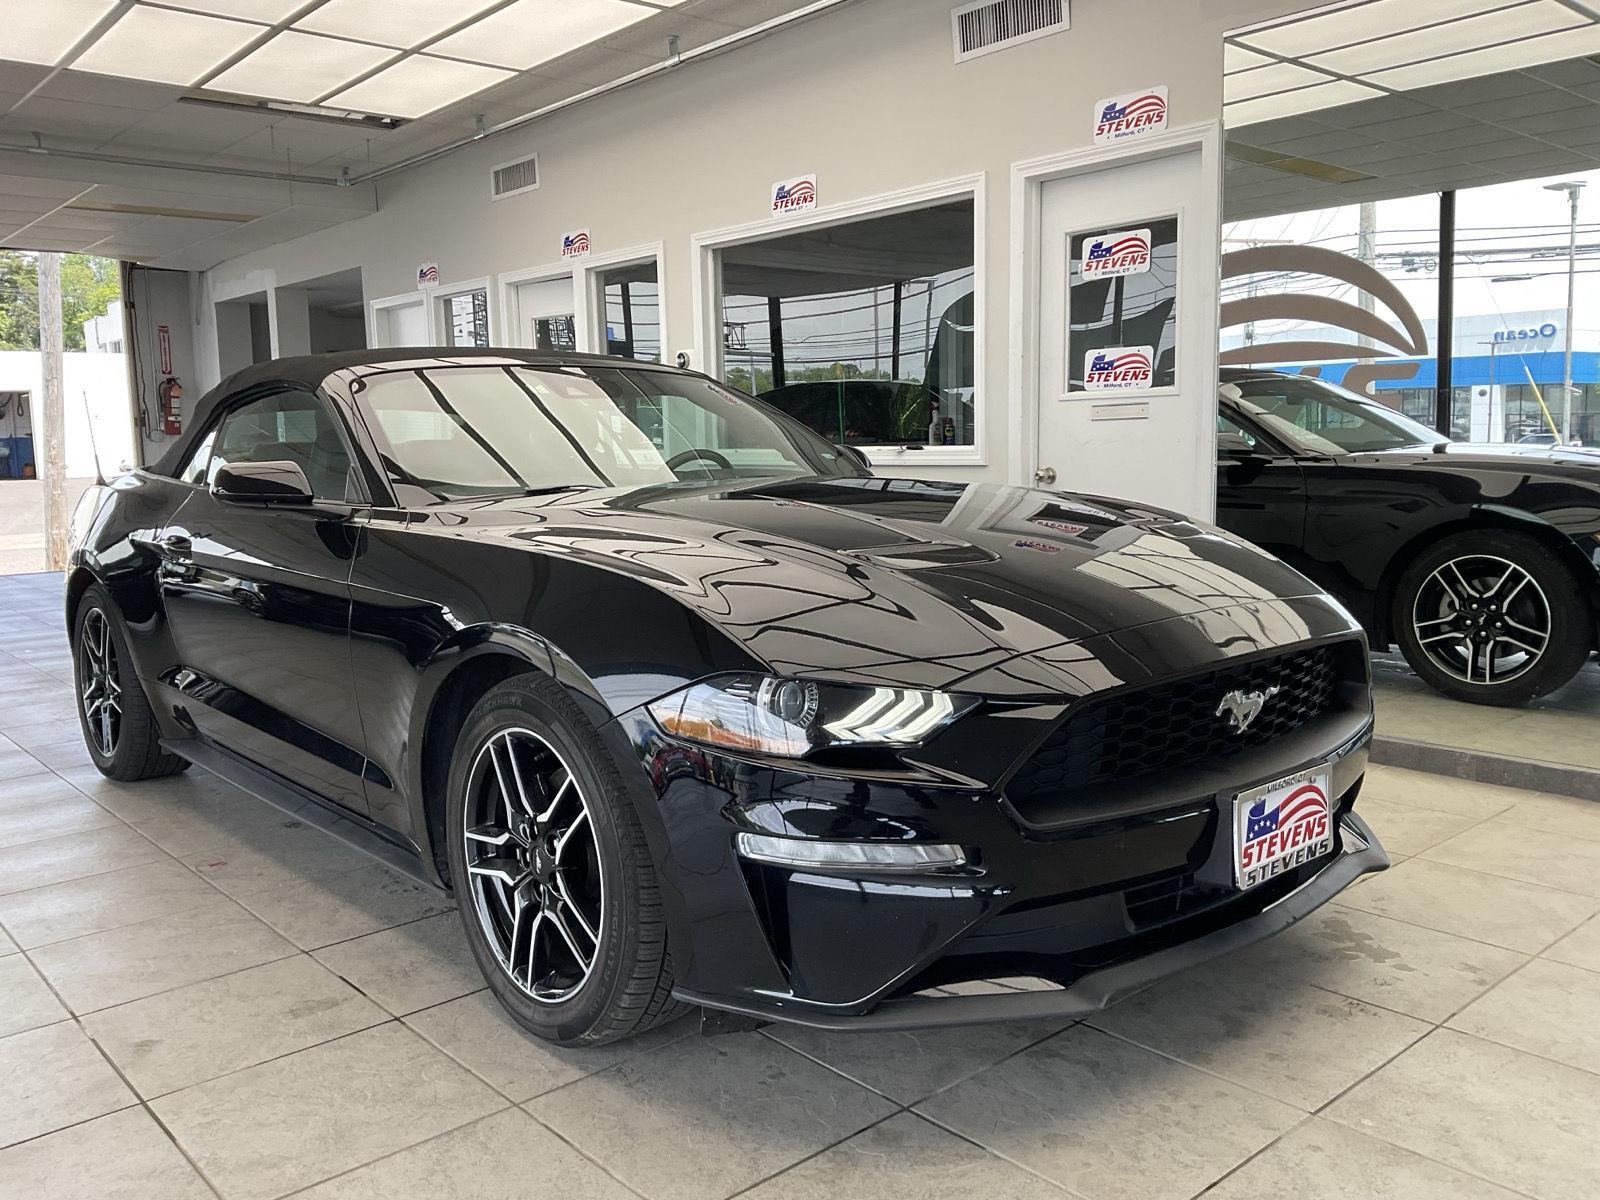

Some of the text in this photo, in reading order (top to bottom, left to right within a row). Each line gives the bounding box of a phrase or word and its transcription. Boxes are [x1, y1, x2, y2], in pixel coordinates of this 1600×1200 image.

[1096, 109, 1166, 136] STEVENS
[772, 193, 815, 211] STEVENS
[562, 243, 590, 256] STEVENS
[1084, 252, 1149, 272] STEVENS
[1086, 369, 1151, 383] STEVENS
[1242, 813, 1328, 869] STEVENS
[1245, 837, 1330, 887] STEVENS
